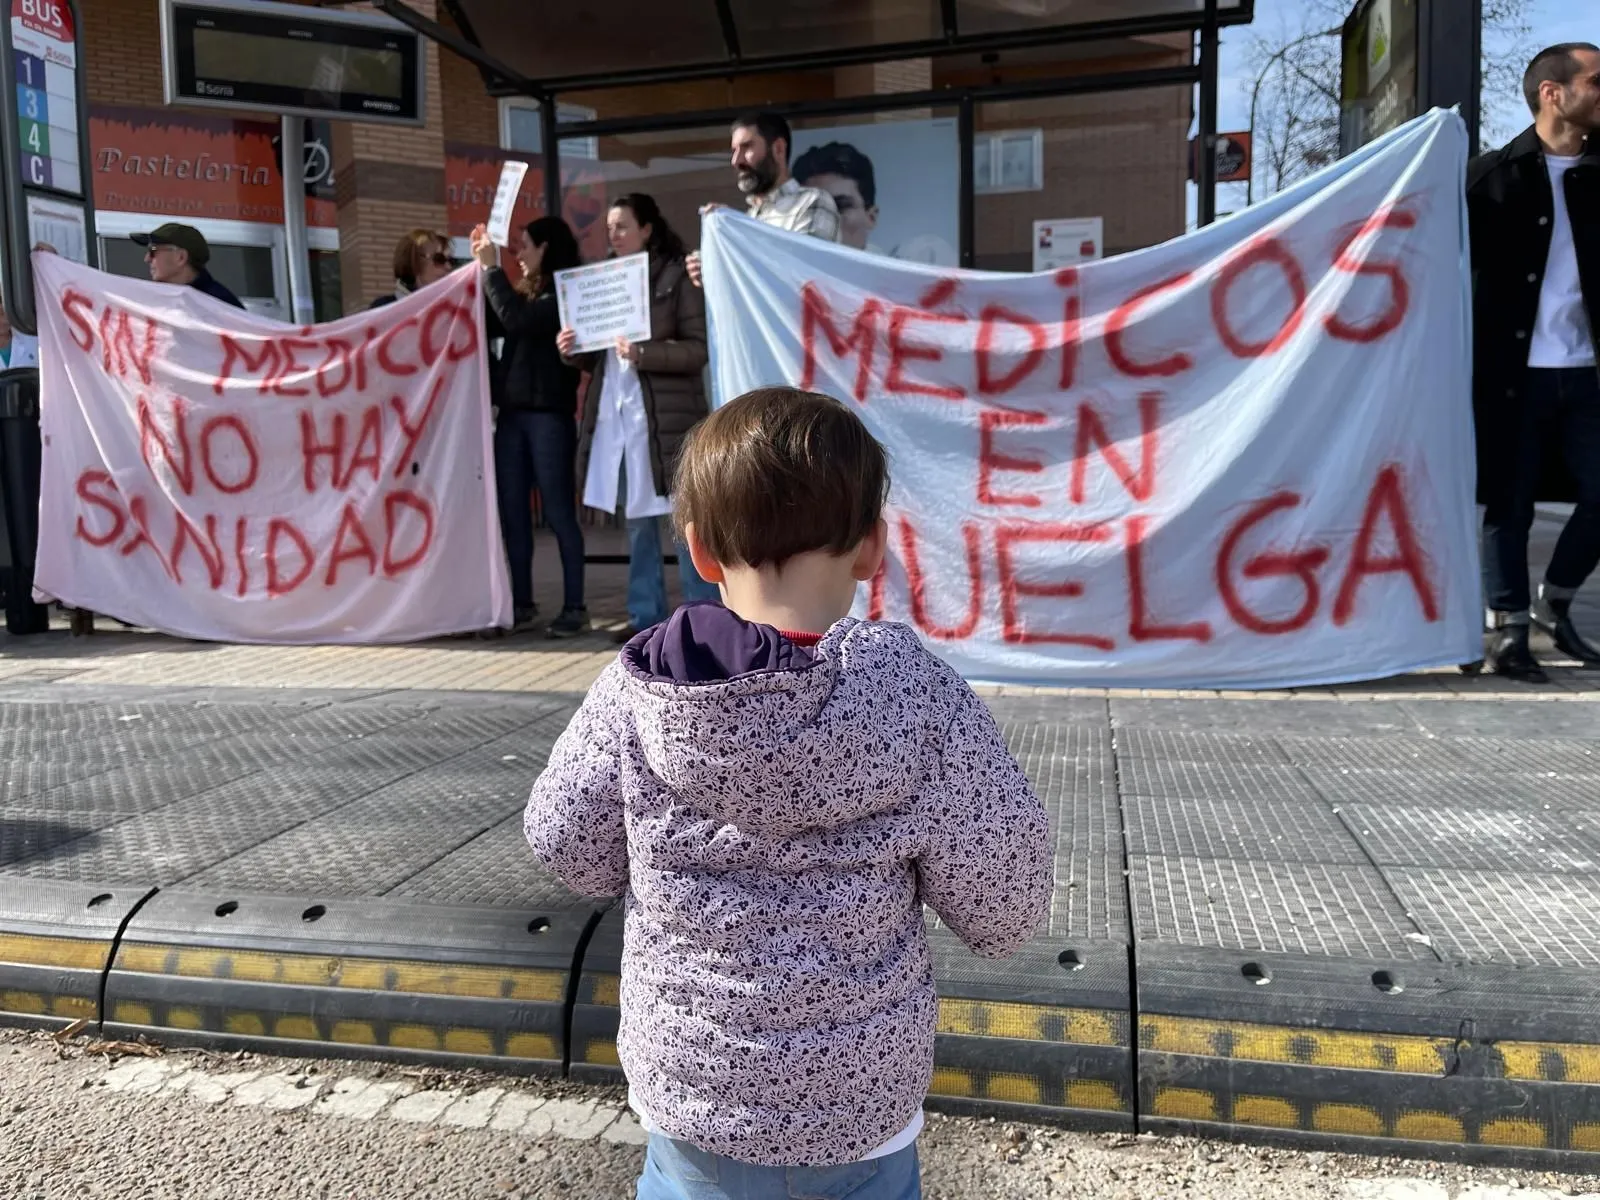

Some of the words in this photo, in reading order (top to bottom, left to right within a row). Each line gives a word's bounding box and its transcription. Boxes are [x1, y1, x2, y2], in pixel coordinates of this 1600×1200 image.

[22, 0, 63, 27] BUS
[21, 56, 32, 85] 1
[25, 90, 38, 119] 3
[29, 123, 42, 152] 4
[30, 155, 45, 185] C
[61, 288, 158, 386] SIN
[136, 395, 259, 494] NO
[300, 374, 445, 493] HAY
[976, 394, 1159, 508] EN
[75, 470, 434, 599] SANIDAD
